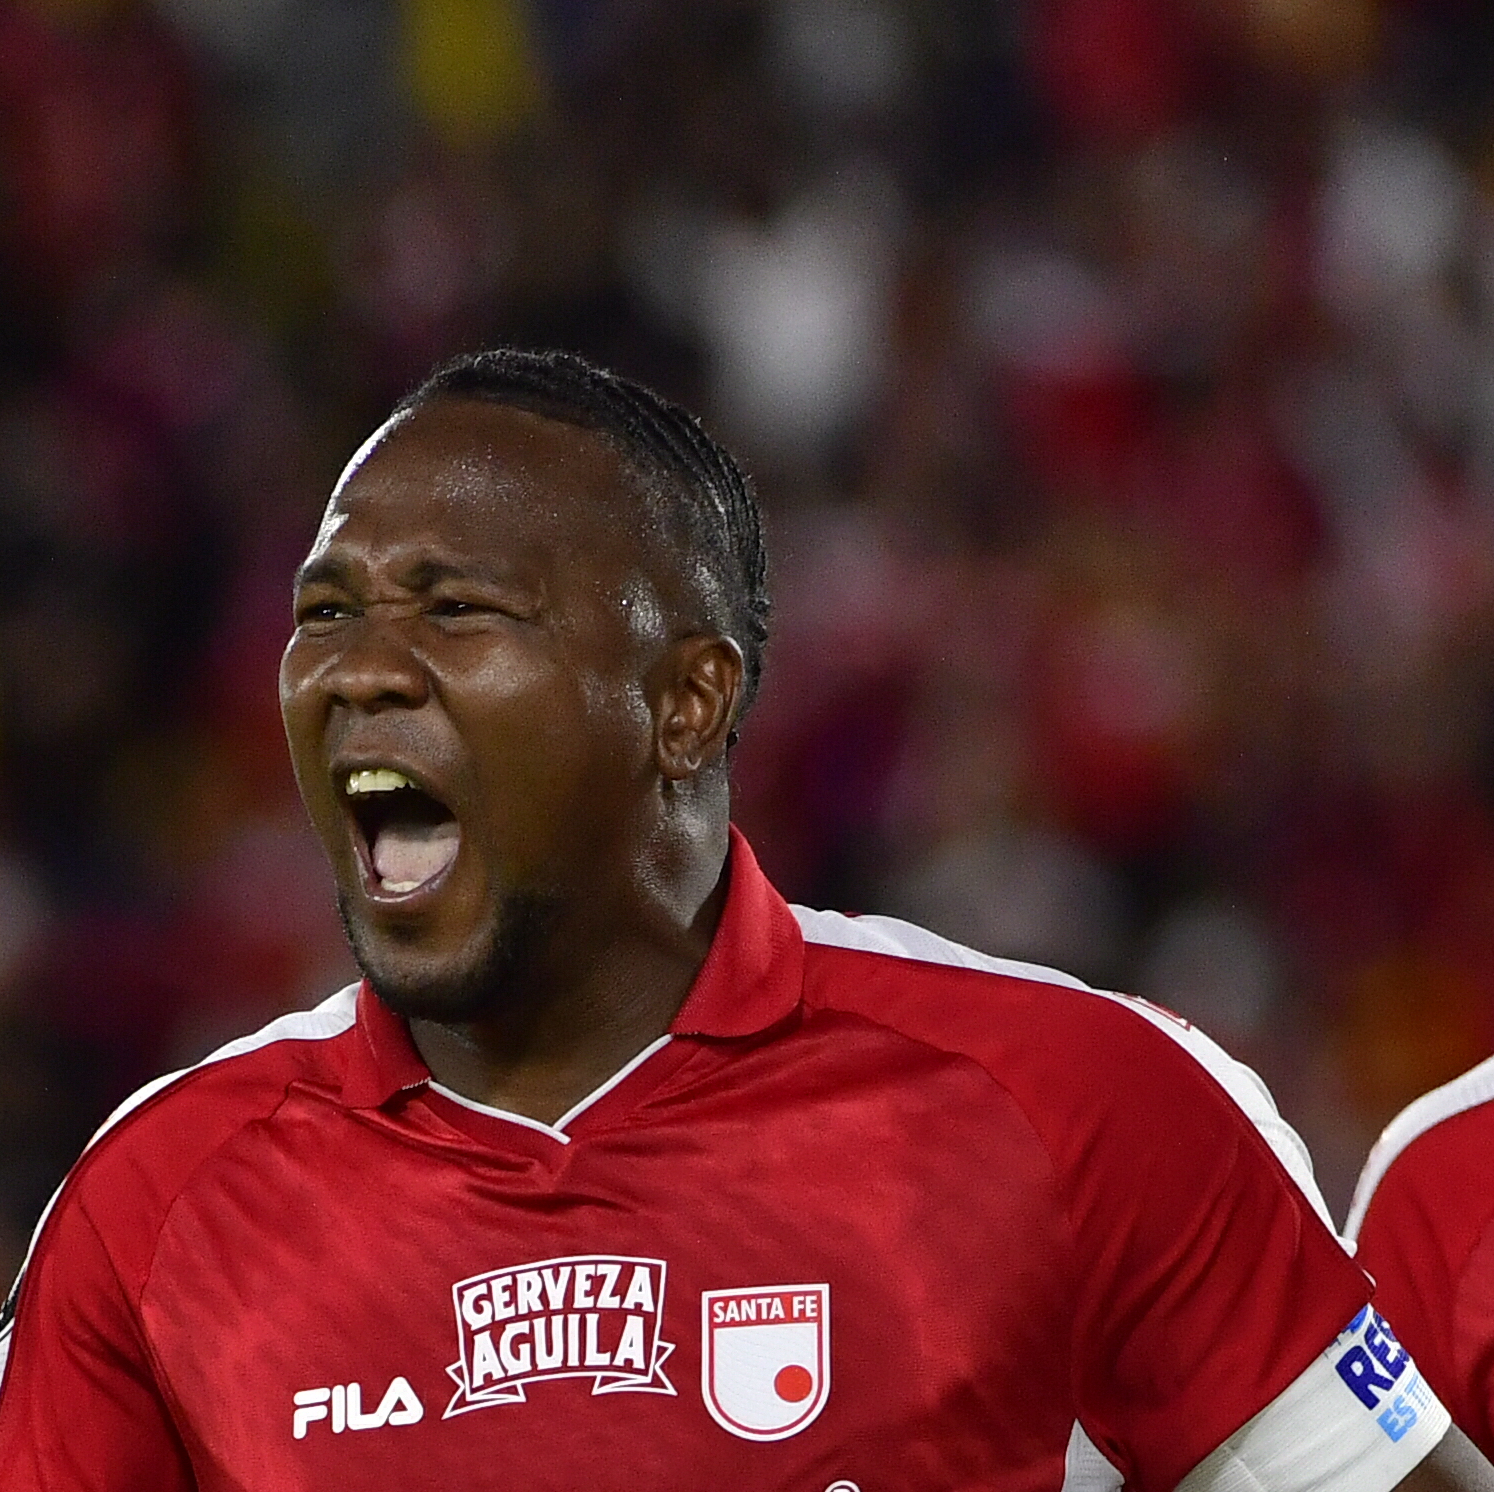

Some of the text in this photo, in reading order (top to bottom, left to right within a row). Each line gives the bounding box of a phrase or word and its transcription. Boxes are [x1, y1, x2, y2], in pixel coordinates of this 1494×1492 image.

[713, 1295, 818, 1323] SANTA FE
[472, 1313, 646, 1388] AGUILA
[293, 1376, 424, 1440] FILA
